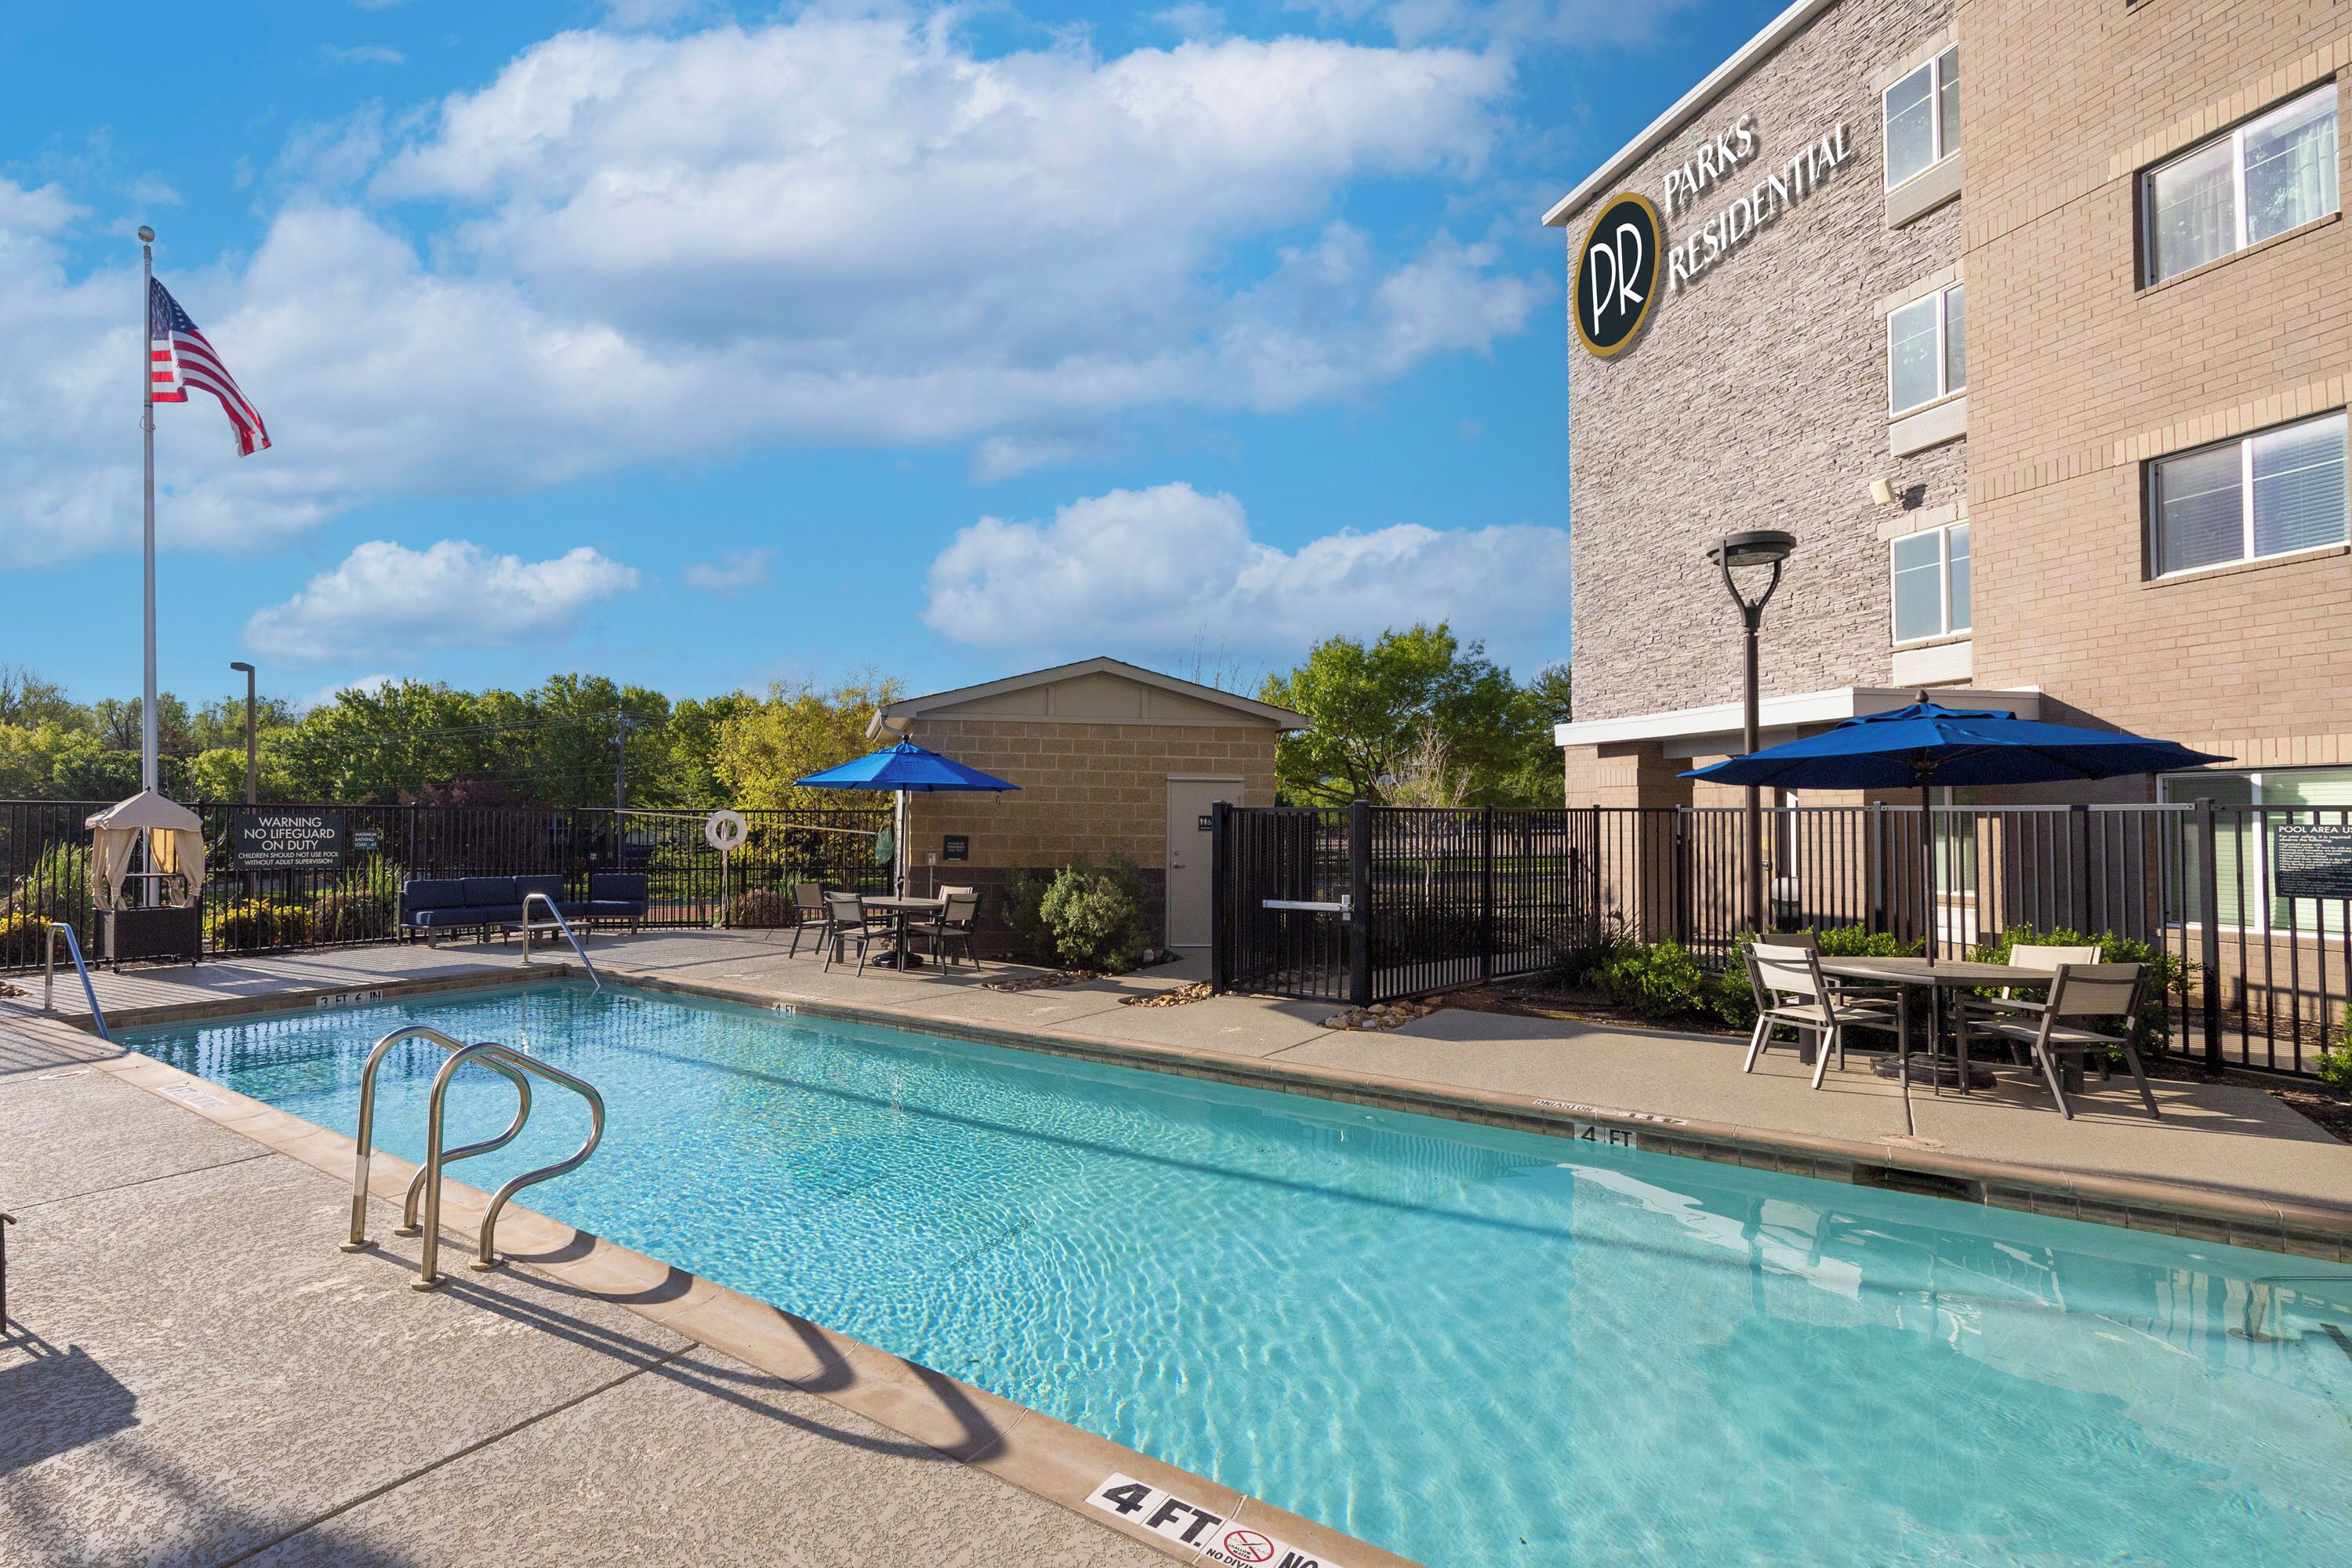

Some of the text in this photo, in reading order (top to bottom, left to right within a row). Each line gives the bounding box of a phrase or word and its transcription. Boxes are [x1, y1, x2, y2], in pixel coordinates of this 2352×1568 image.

[1664, 114, 1751, 214] PARKS
[1668, 123, 1851, 290] RESIDENTIAL
[1590, 223, 1644, 336] PR
[259, 817, 321, 827] WARNING
[245, 829, 335, 839] NO LIFEGUARD
[262, 840, 318, 851] ON DUTY
[1535, 1100, 1574, 1109] DIVING
[1581, 1127, 1632, 1147] 4 FT
[1102, 1483, 1152, 1515] 4
[1206, 1548, 1223, 1559] NO
[1229, 1543, 1251, 1555] SHALLOW
[1232, 1549, 1250, 1559] WATER
